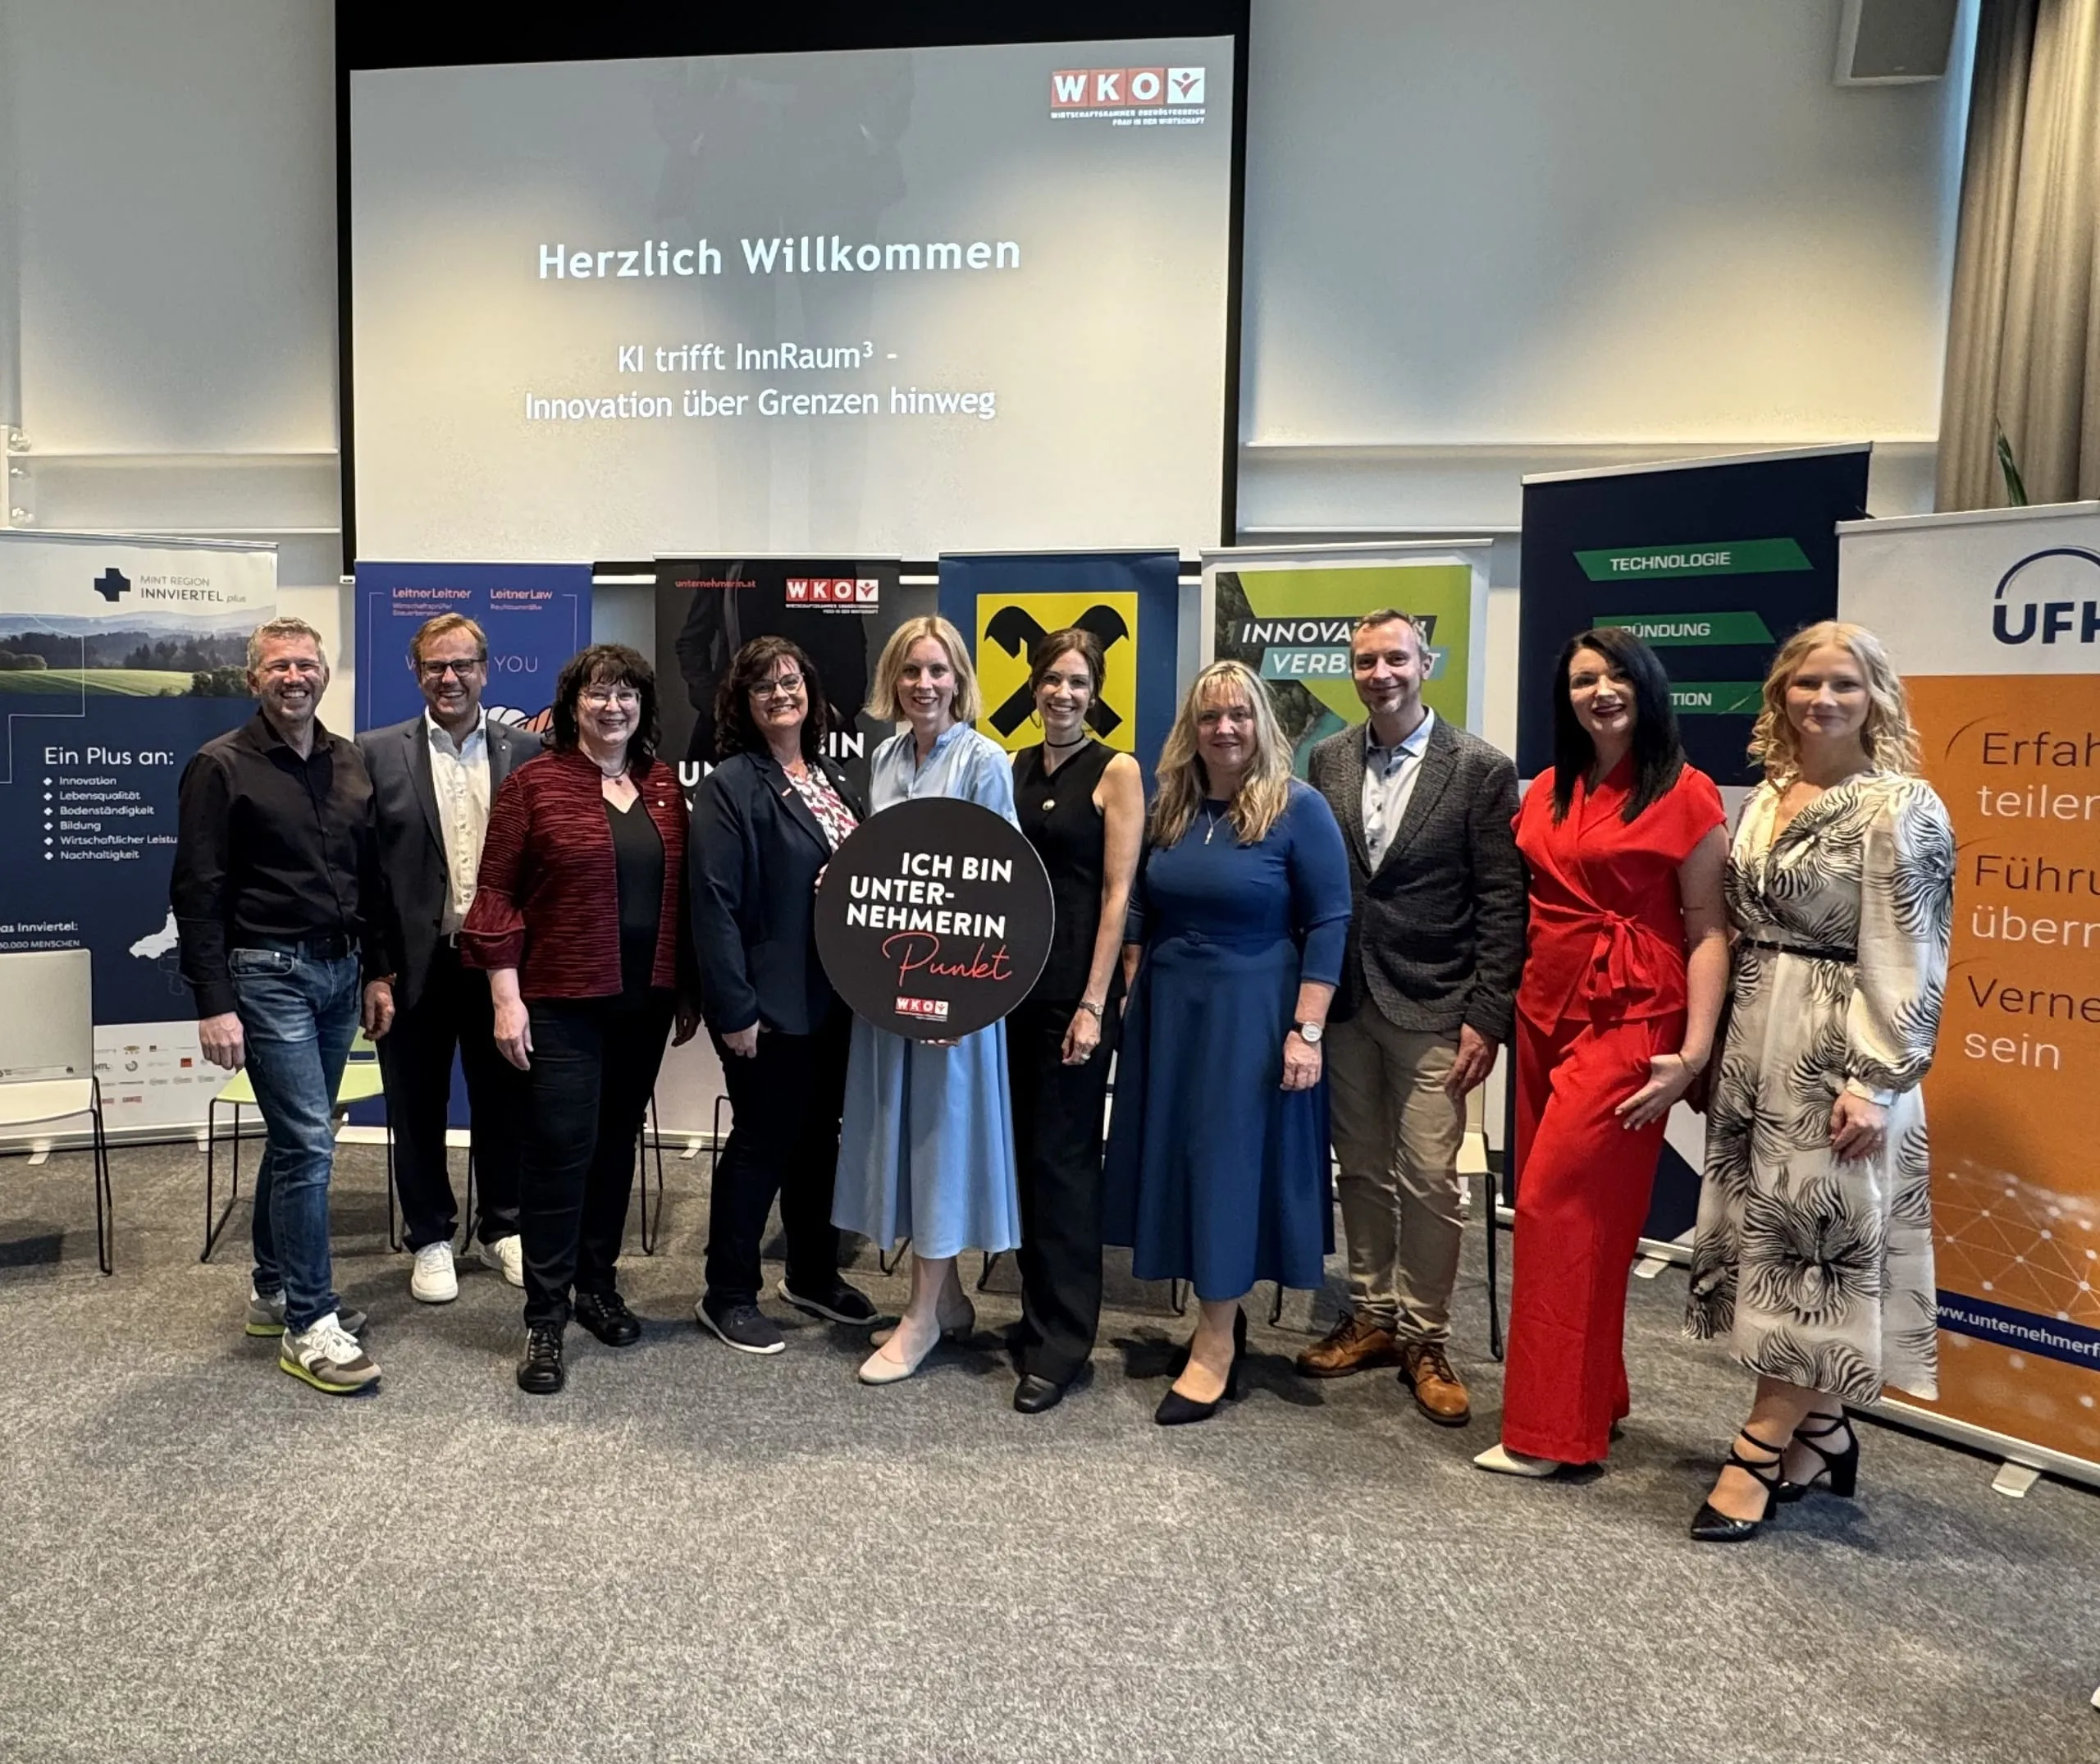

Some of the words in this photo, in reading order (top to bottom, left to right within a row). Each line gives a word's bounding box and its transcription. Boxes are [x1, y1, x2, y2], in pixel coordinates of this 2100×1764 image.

[1053, 72, 1161, 103] WKO
[539, 238, 722, 280] Herzlich
[741, 235, 1021, 274] Willkommen
[618, 345, 645, 373] KI
[655, 344, 726, 372] trifft
[737, 340, 874, 371] InnRaum³
[525, 391, 673, 420] Innovation
[683, 388, 746, 416] über
[758, 388, 879, 416] Grenzen
[890, 386, 996, 420] hinweg
[1610, 551, 1732, 572] TECHNOLOGIE
[140, 575, 168, 585] MINT
[170, 576, 210, 587] REGION
[674, 577, 756, 588] unternehmerin.at
[141, 587, 224, 602] INNVIERTEL
[226, 594, 247, 604] plus
[392, 587, 472, 599] LeitnerLeitner
[490, 587, 553, 600] LeitnerLaw
[787, 581, 853, 600] WKO
[1619, 622, 1711, 638] RÜNDUNG
[493, 656, 539, 673] YOU
[1670, 692, 1713, 706] TION
[819, 731, 865, 759] IN
[45, 747, 80, 765] Ein
[87, 747, 132, 765] Plus
[139, 748, 174, 765] an:
[59, 775, 117, 786] Innovation
[59, 790, 142, 802] Lebensqualität
[60, 805, 155, 817] Bodenständigkeit
[60, 820, 102, 832] Bildung
[60, 834, 145, 845] Wirtschaftlicher
[147, 834, 178, 844] Leistu
[60, 849, 141, 861] Nachhaltigkeit
[902, 852, 953, 879] ICH
[961, 856, 1013, 884] BIN
[850, 875, 956, 906] UNTER-
[17, 921, 79, 933] Innviertel:
[846, 902, 1007, 940] NEHMERIN
[30, 939, 80, 948] MENSCHEN
[882, 931, 1013, 988] Punkt
[896, 996, 934, 1013] WKO
[1963, 1032, 2061, 1071] sein
[1936, 1305, 2100, 1359] ww.unternehmerf
